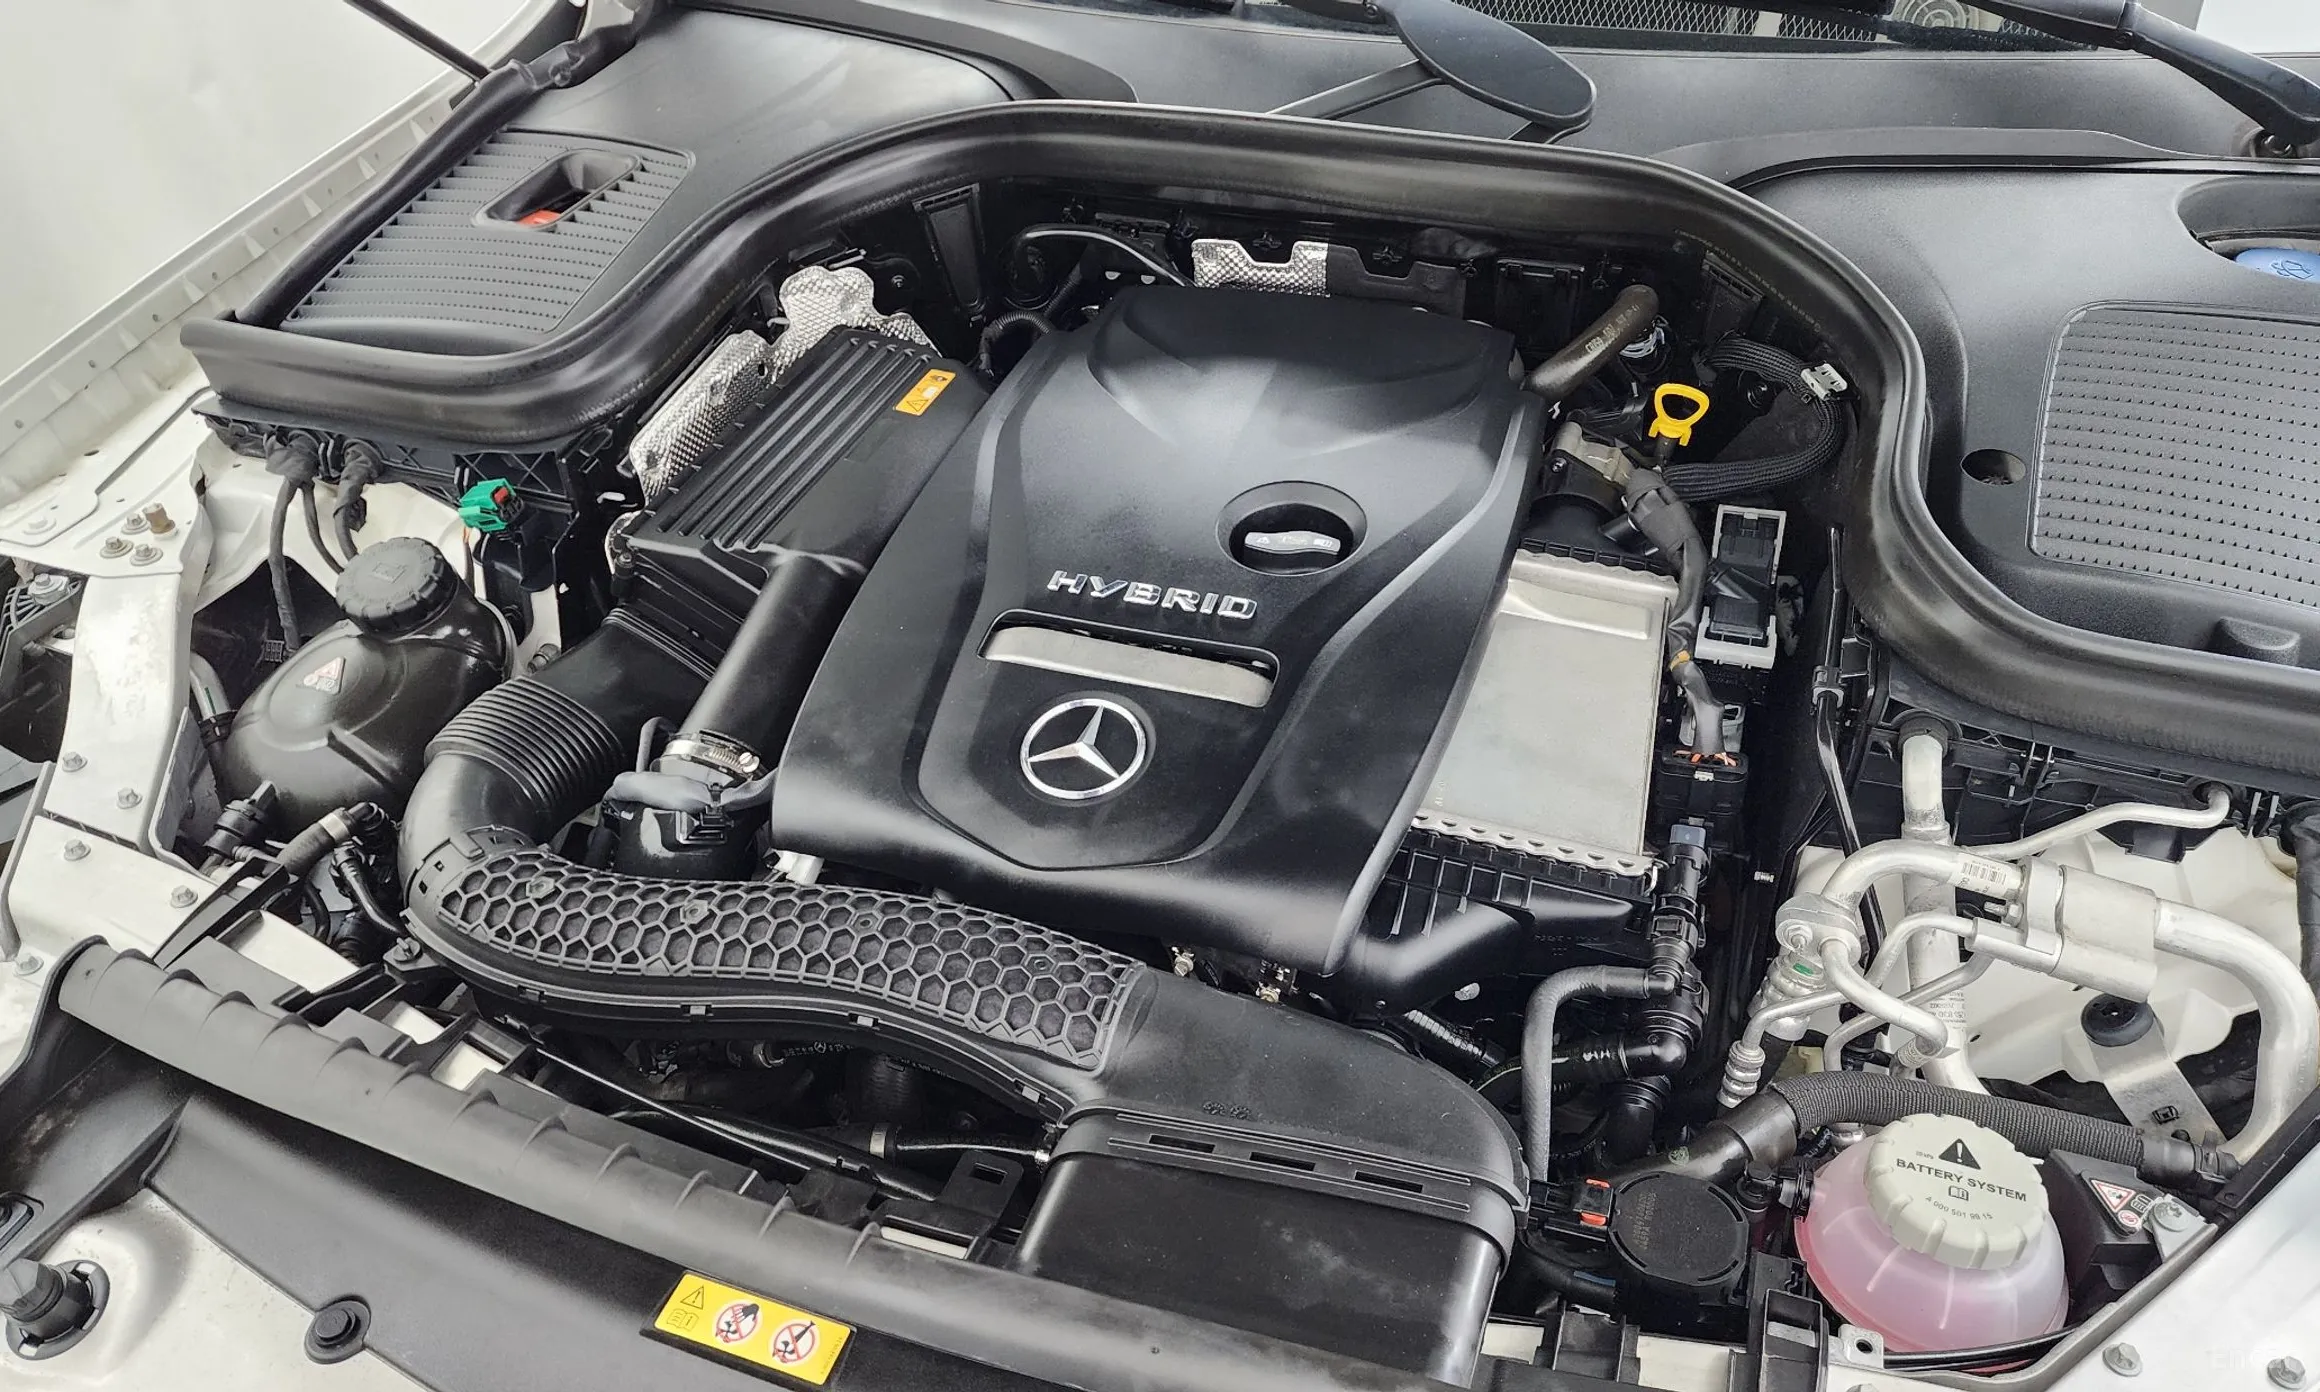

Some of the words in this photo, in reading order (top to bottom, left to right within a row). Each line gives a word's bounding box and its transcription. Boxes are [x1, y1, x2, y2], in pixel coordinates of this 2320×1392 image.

[1047, 570, 1258, 620] HYBRID
[1896, 1158, 1963, 1183] BATTERY
[1967, 1178, 2027, 1202] SYSTEM
[1933, 1200, 1950, 1213] 000
